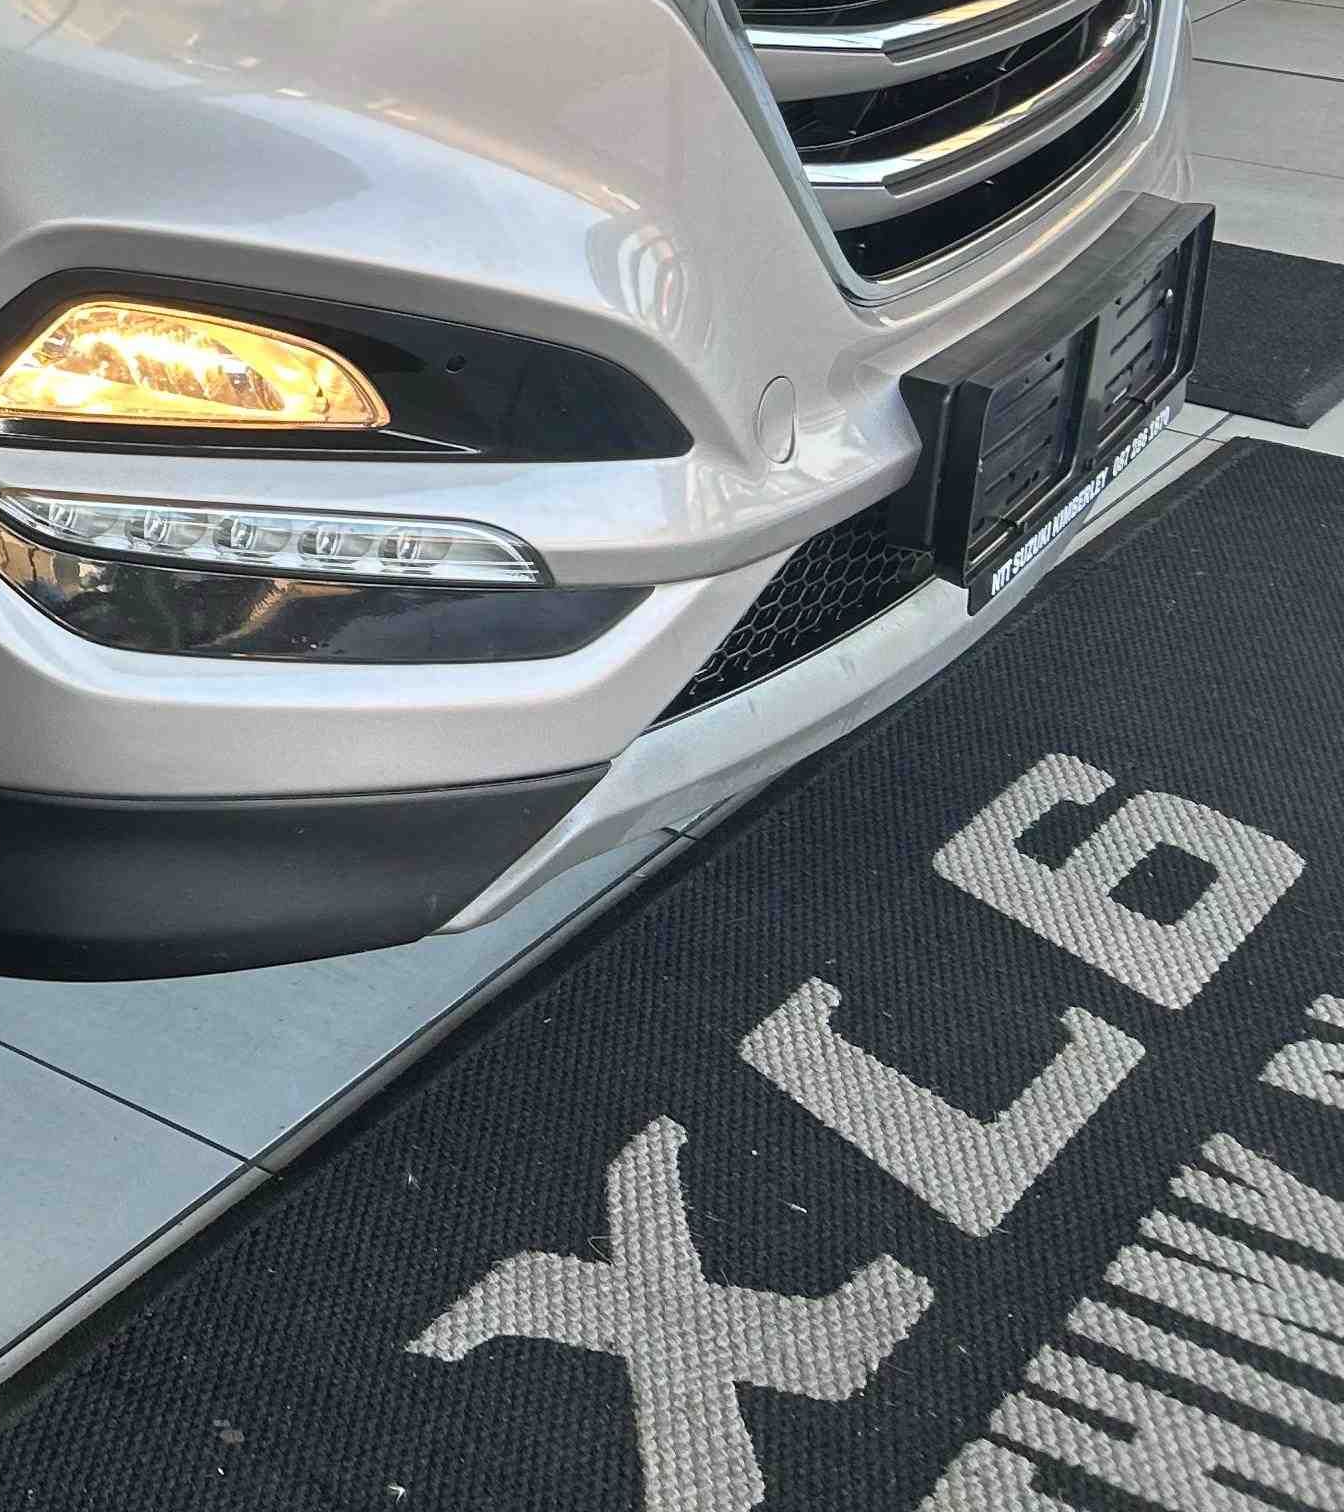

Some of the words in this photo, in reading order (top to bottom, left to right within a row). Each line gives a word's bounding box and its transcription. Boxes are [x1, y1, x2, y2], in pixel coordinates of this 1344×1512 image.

[992, 558, 1013, 596] NTT
[1012, 521, 1052, 574] SUZUKI
[1052, 467, 1109, 538] KIMBERLEY
